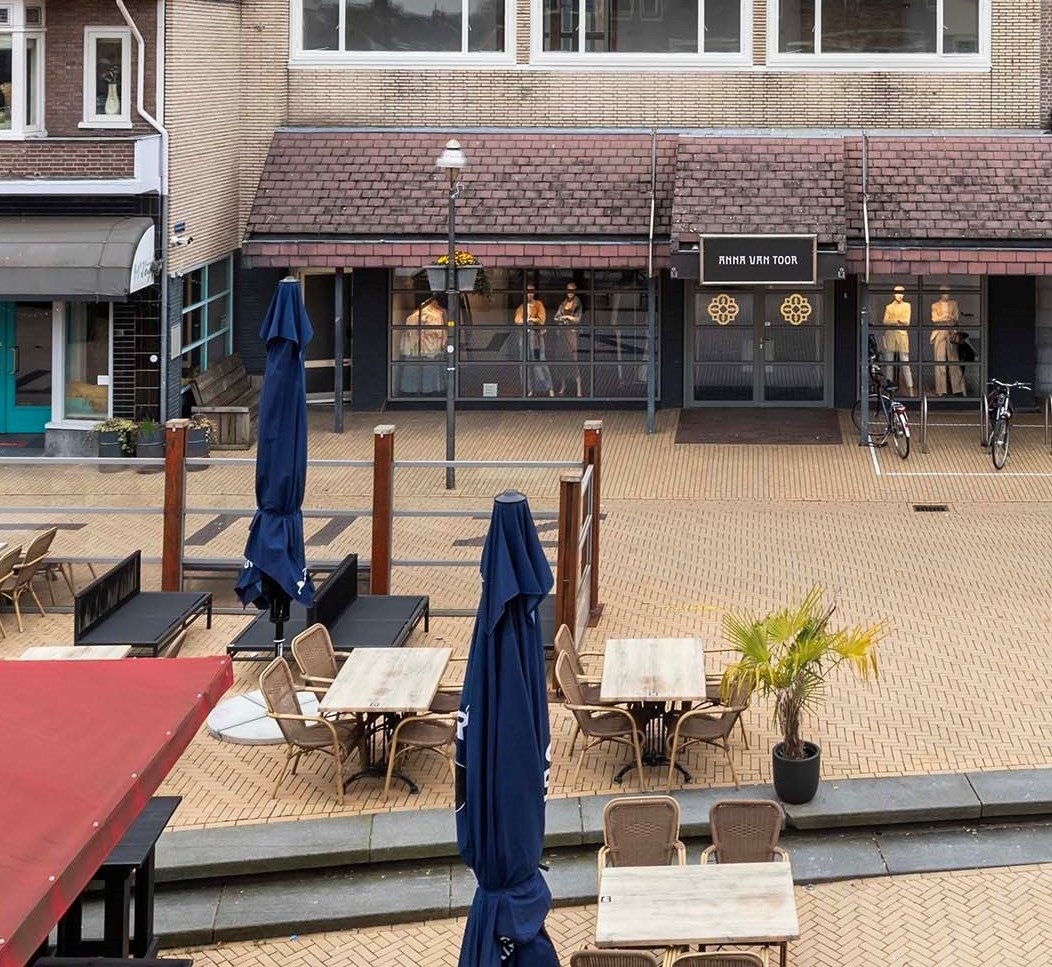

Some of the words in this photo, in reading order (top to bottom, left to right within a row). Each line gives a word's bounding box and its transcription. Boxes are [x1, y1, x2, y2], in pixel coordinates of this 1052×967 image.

[718, 255, 746, 265] ANNA
[748, 255, 770, 265] VAN
[772, 255, 798, 265] TOOR
